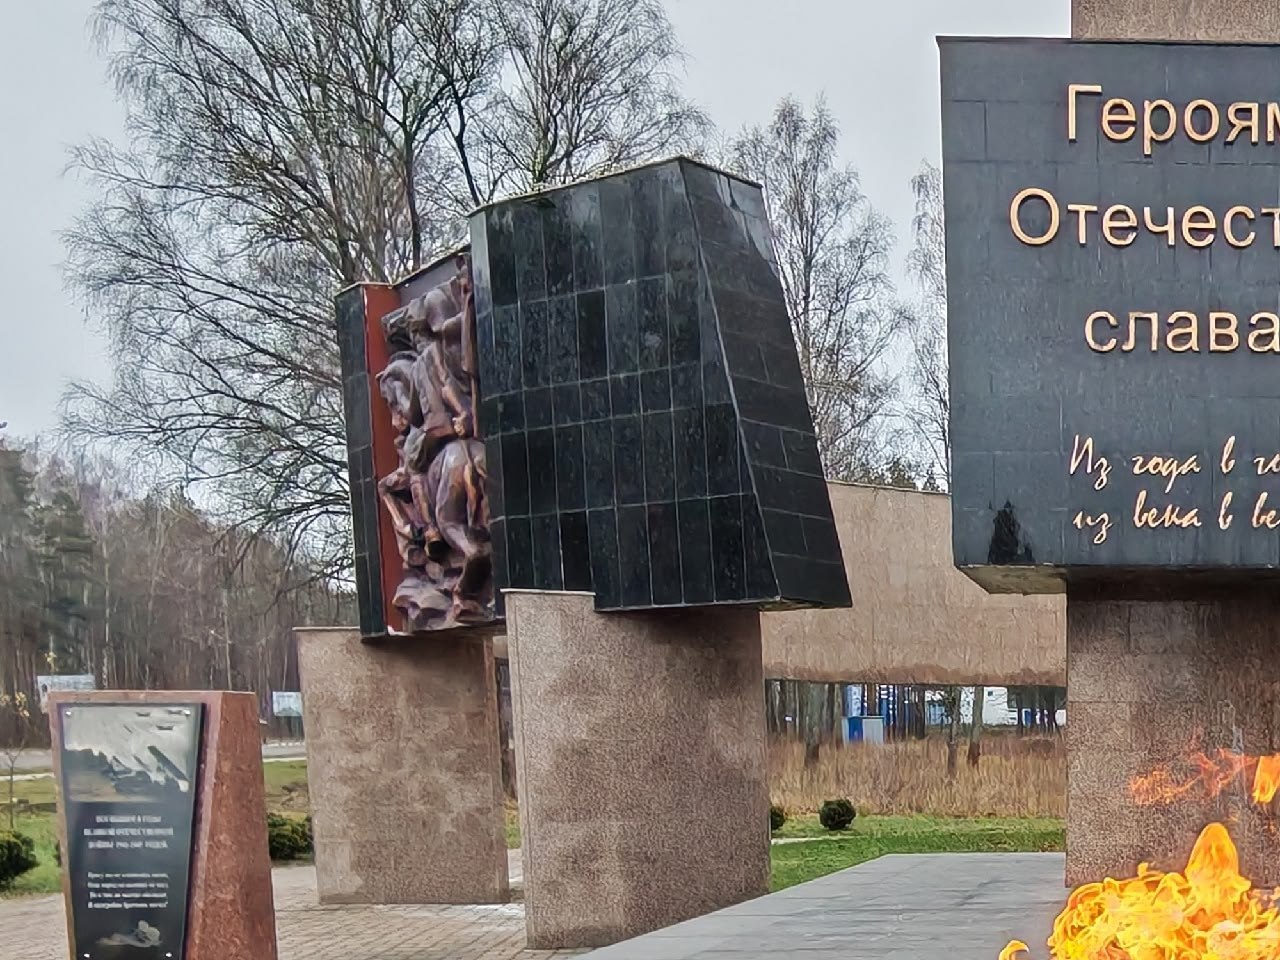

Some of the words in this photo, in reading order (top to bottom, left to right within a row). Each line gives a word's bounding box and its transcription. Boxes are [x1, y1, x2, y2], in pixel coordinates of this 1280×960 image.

[1069, 434, 1113, 491] Из
[1131, 454, 1201, 494] года
[1220, 435, 1236, 475] в
[1072, 510, 1113, 545] из
[1133, 489, 1202, 529] века
[1218, 491, 1234, 530] в
